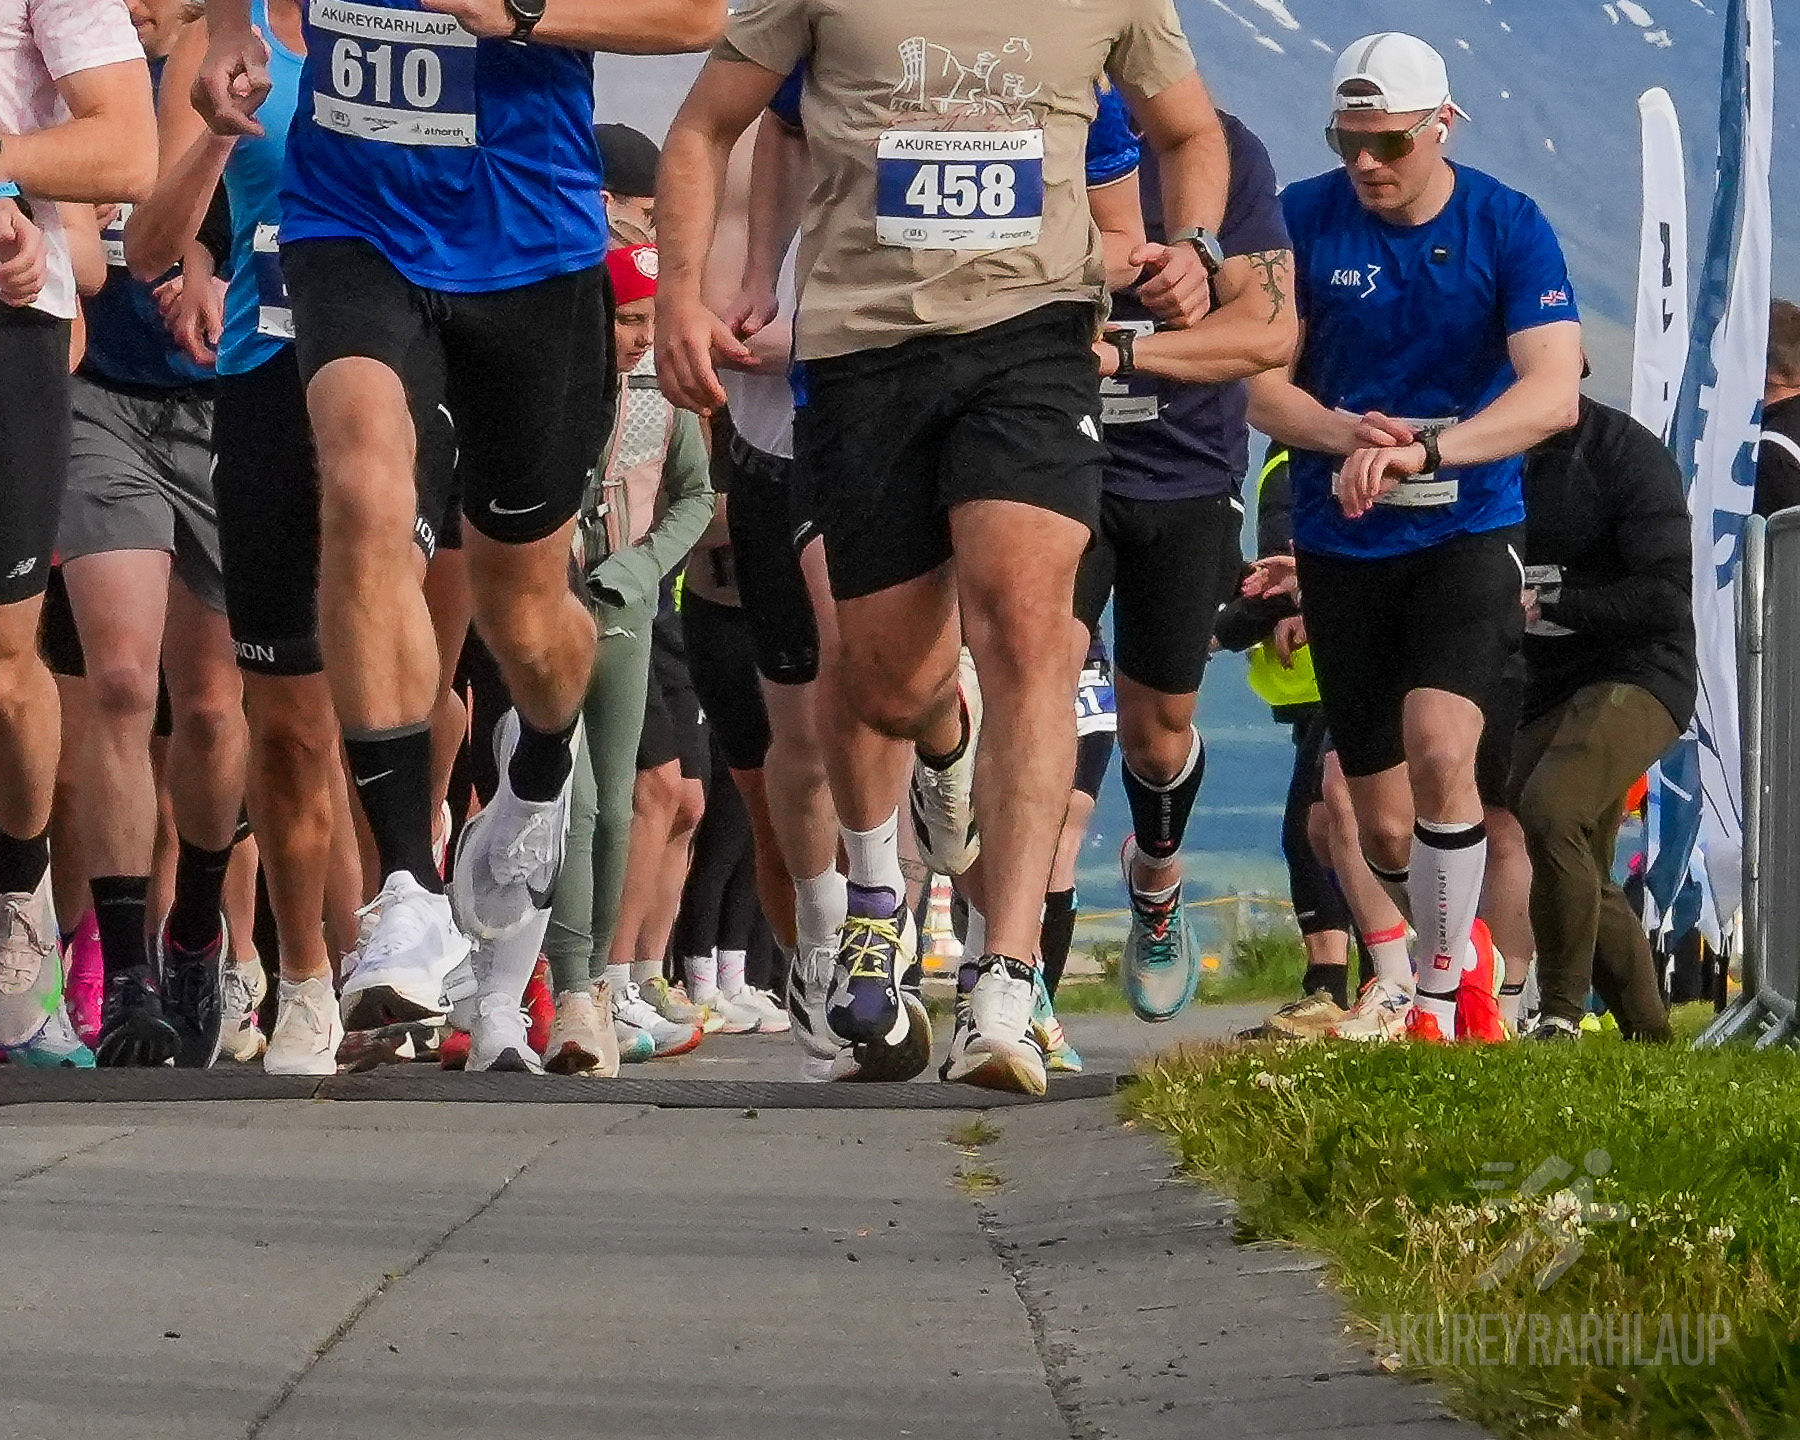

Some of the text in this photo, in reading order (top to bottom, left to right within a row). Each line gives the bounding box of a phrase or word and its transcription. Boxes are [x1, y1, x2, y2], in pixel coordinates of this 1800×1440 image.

[321, 7, 458, 36] AKUREYRARHLAUP
[331, 38, 442, 108] 610
[895, 139, 1028, 151] AKUREYRARHLAUP
[906, 163, 1017, 217] 458
